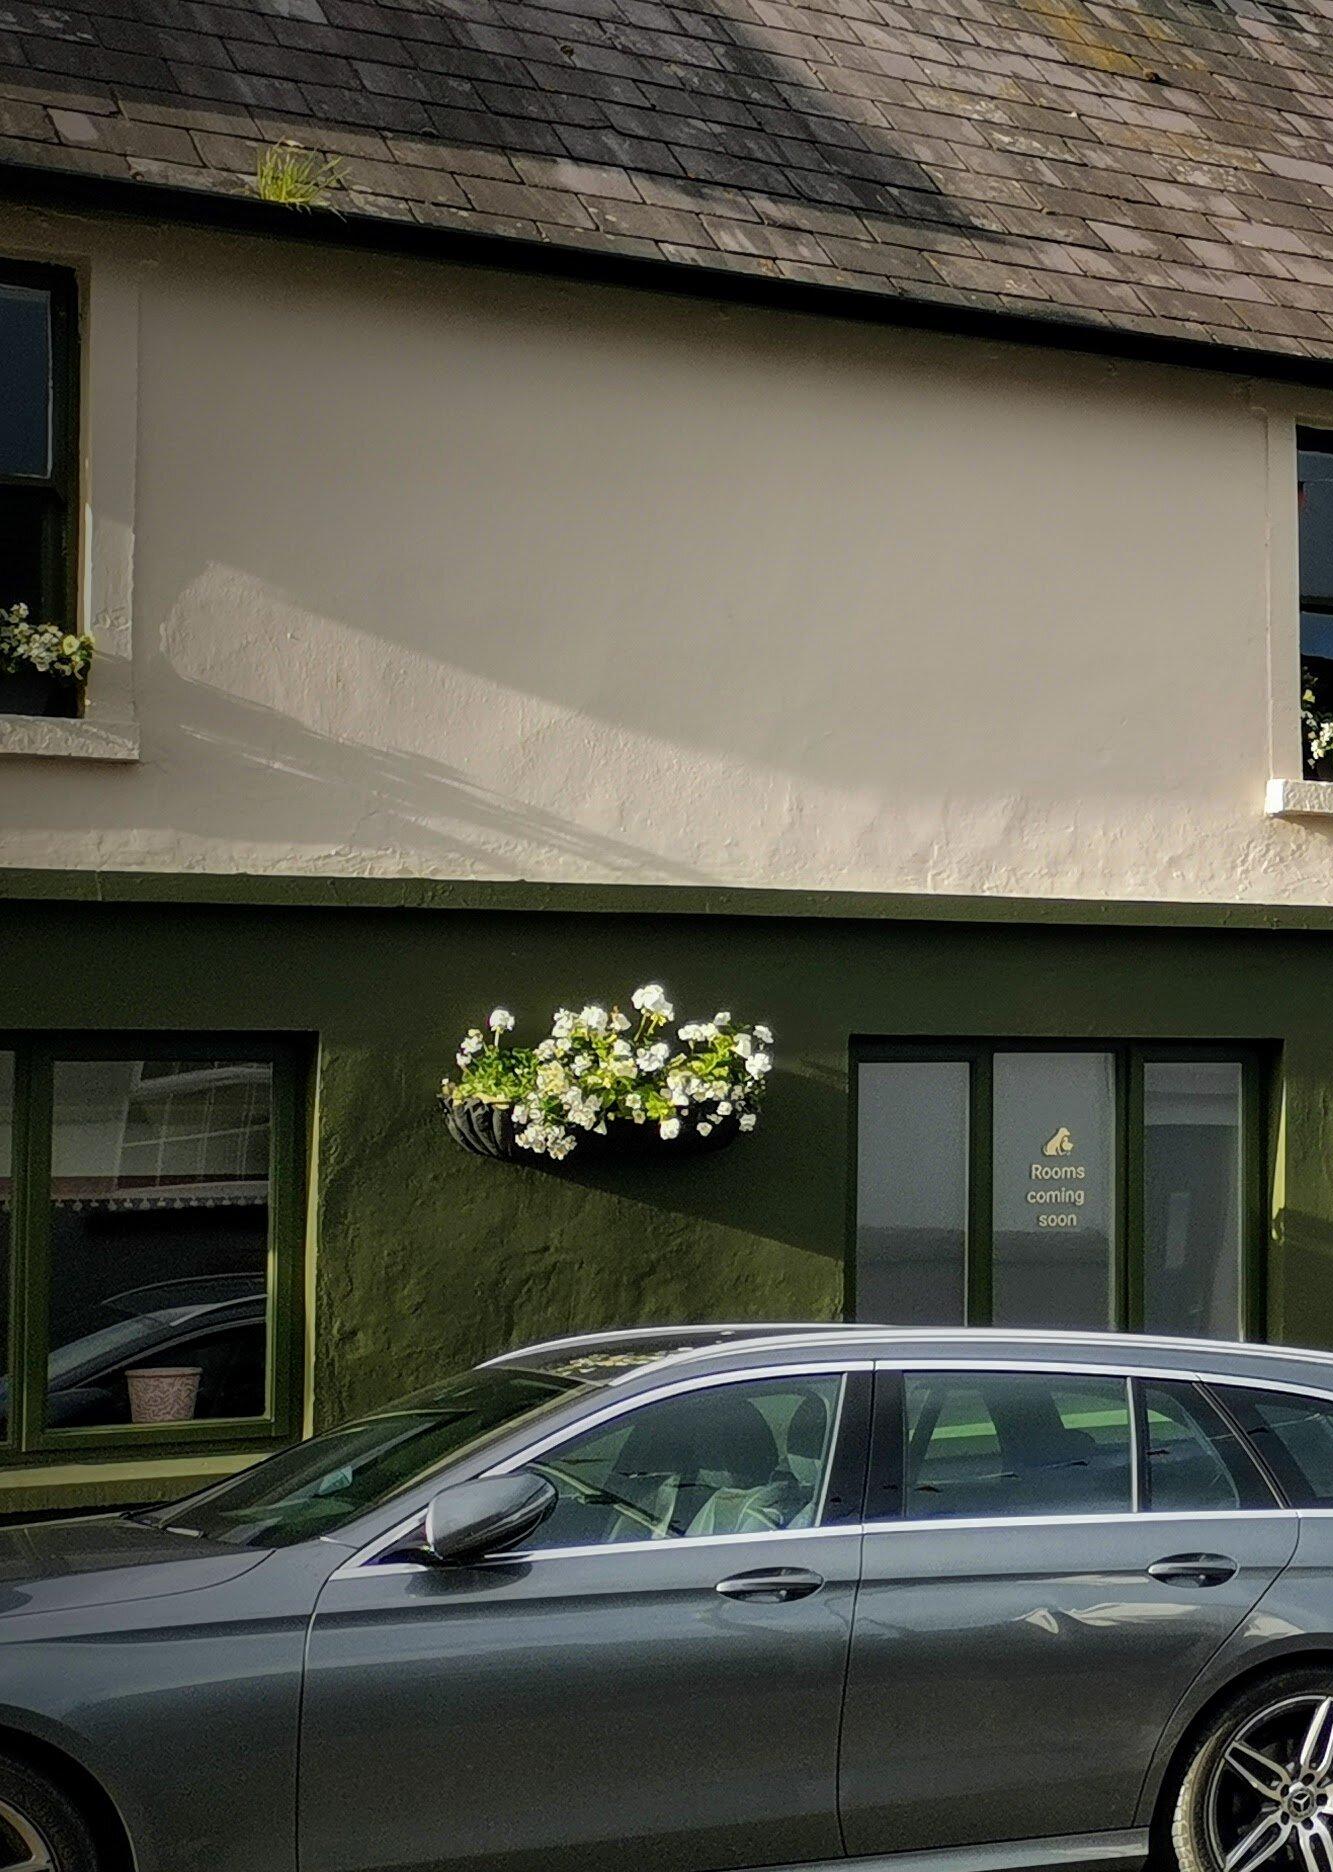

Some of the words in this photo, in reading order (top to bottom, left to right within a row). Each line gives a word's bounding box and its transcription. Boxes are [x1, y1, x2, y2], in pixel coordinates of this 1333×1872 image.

[1031, 1164, 1085, 1180] Rooms
[1027, 1187, 1085, 1206] coming
[1038, 1213, 1077, 1227] soon
